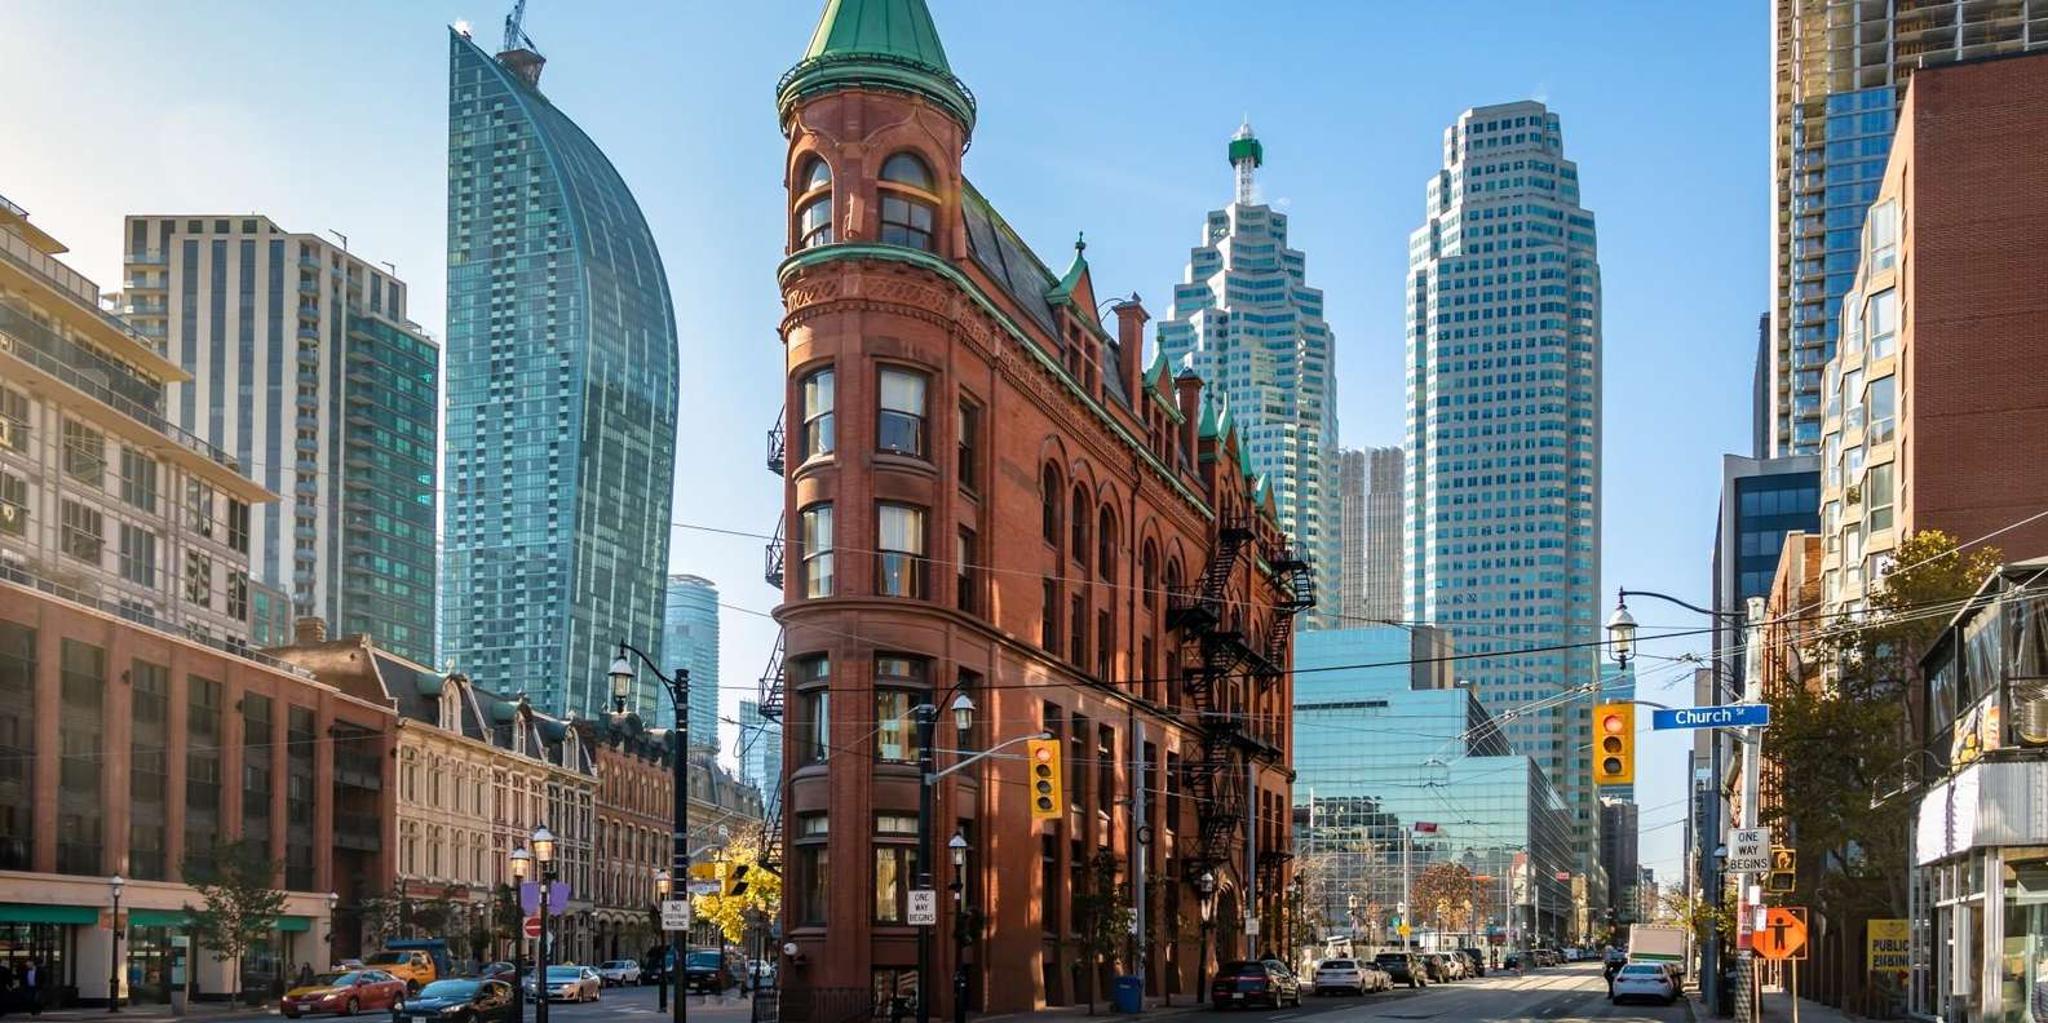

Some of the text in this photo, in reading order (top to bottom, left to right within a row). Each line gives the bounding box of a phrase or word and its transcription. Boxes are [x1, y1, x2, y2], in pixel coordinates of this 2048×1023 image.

[1675, 709, 1731, 724] Church
[1738, 831, 1758, 842] ONE
[1738, 845, 1758, 856] WAY
[1730, 858, 1767, 870] BEGINS
[914, 893, 930, 901] ONE
[915, 903, 929, 911] WAY
[1873, 939, 1910, 952] PUBLIC
